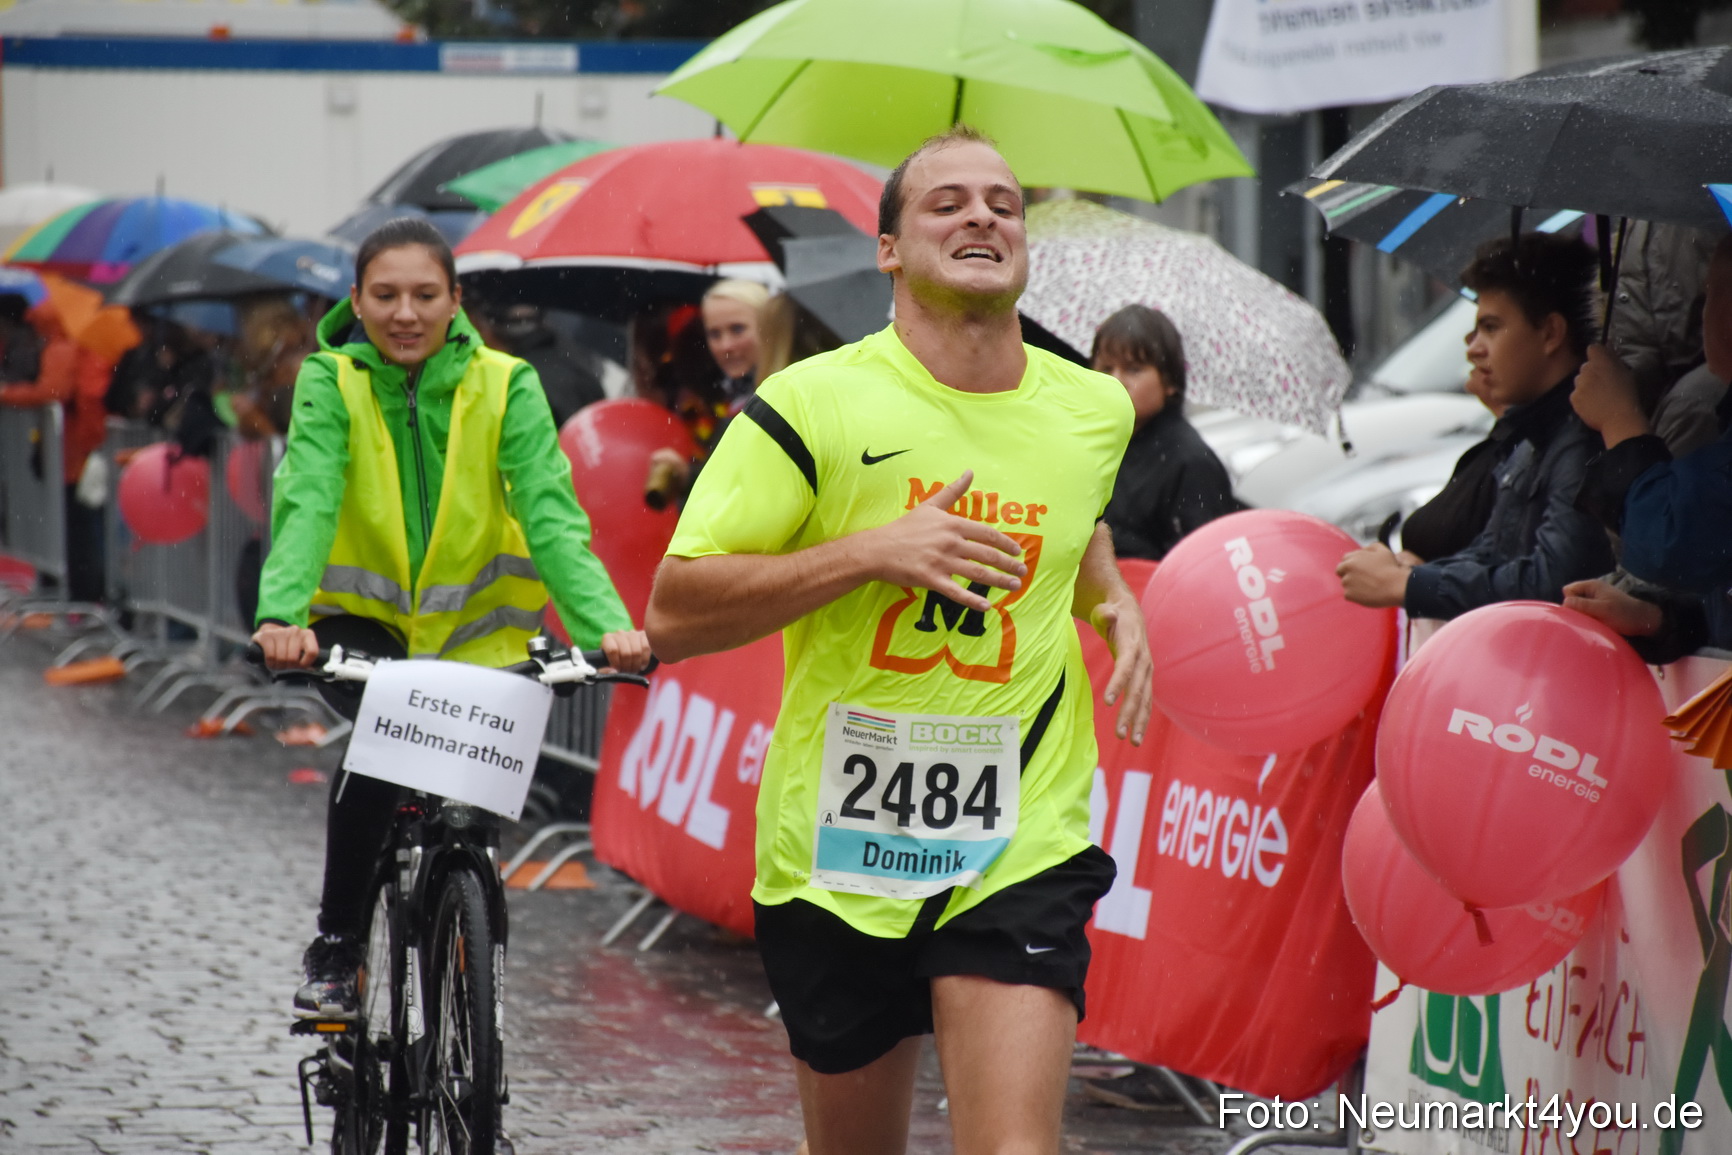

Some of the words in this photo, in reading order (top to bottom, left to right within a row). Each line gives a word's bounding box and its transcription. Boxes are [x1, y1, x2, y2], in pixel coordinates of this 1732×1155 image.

[408, 689, 462, 719] Erste
[468, 705, 515, 734] Frau
[374, 716, 523, 774] Halbmarathon
[842, 726, 898, 745] NeuerMarkt
[909, 722, 1003, 746] BOCK
[840, 753, 1002, 830] 2484
[824, 812, 833, 824] A
[862, 841, 967, 875] Dominik
